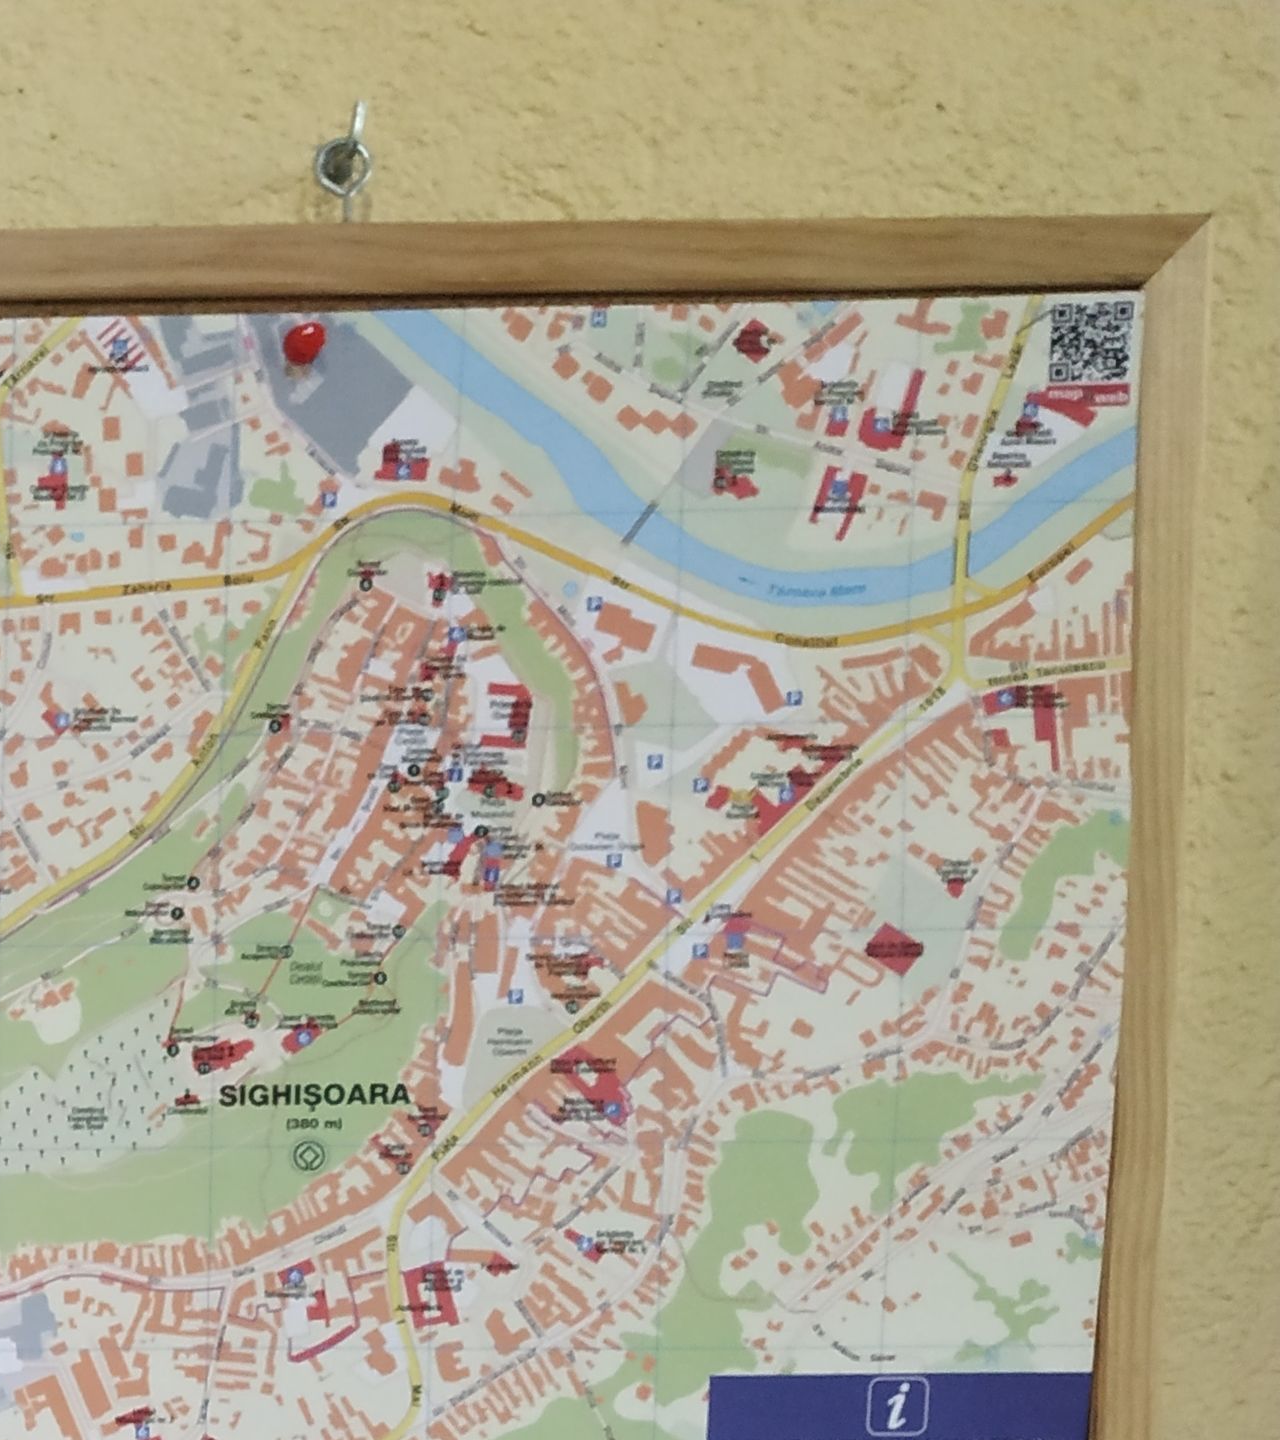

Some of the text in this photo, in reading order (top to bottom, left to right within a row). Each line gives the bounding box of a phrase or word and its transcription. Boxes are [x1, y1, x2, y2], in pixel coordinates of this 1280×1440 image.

[219, 1083, 412, 1111] SIGHIȘOARA
[286, 1117, 342, 1131] (380 m)
